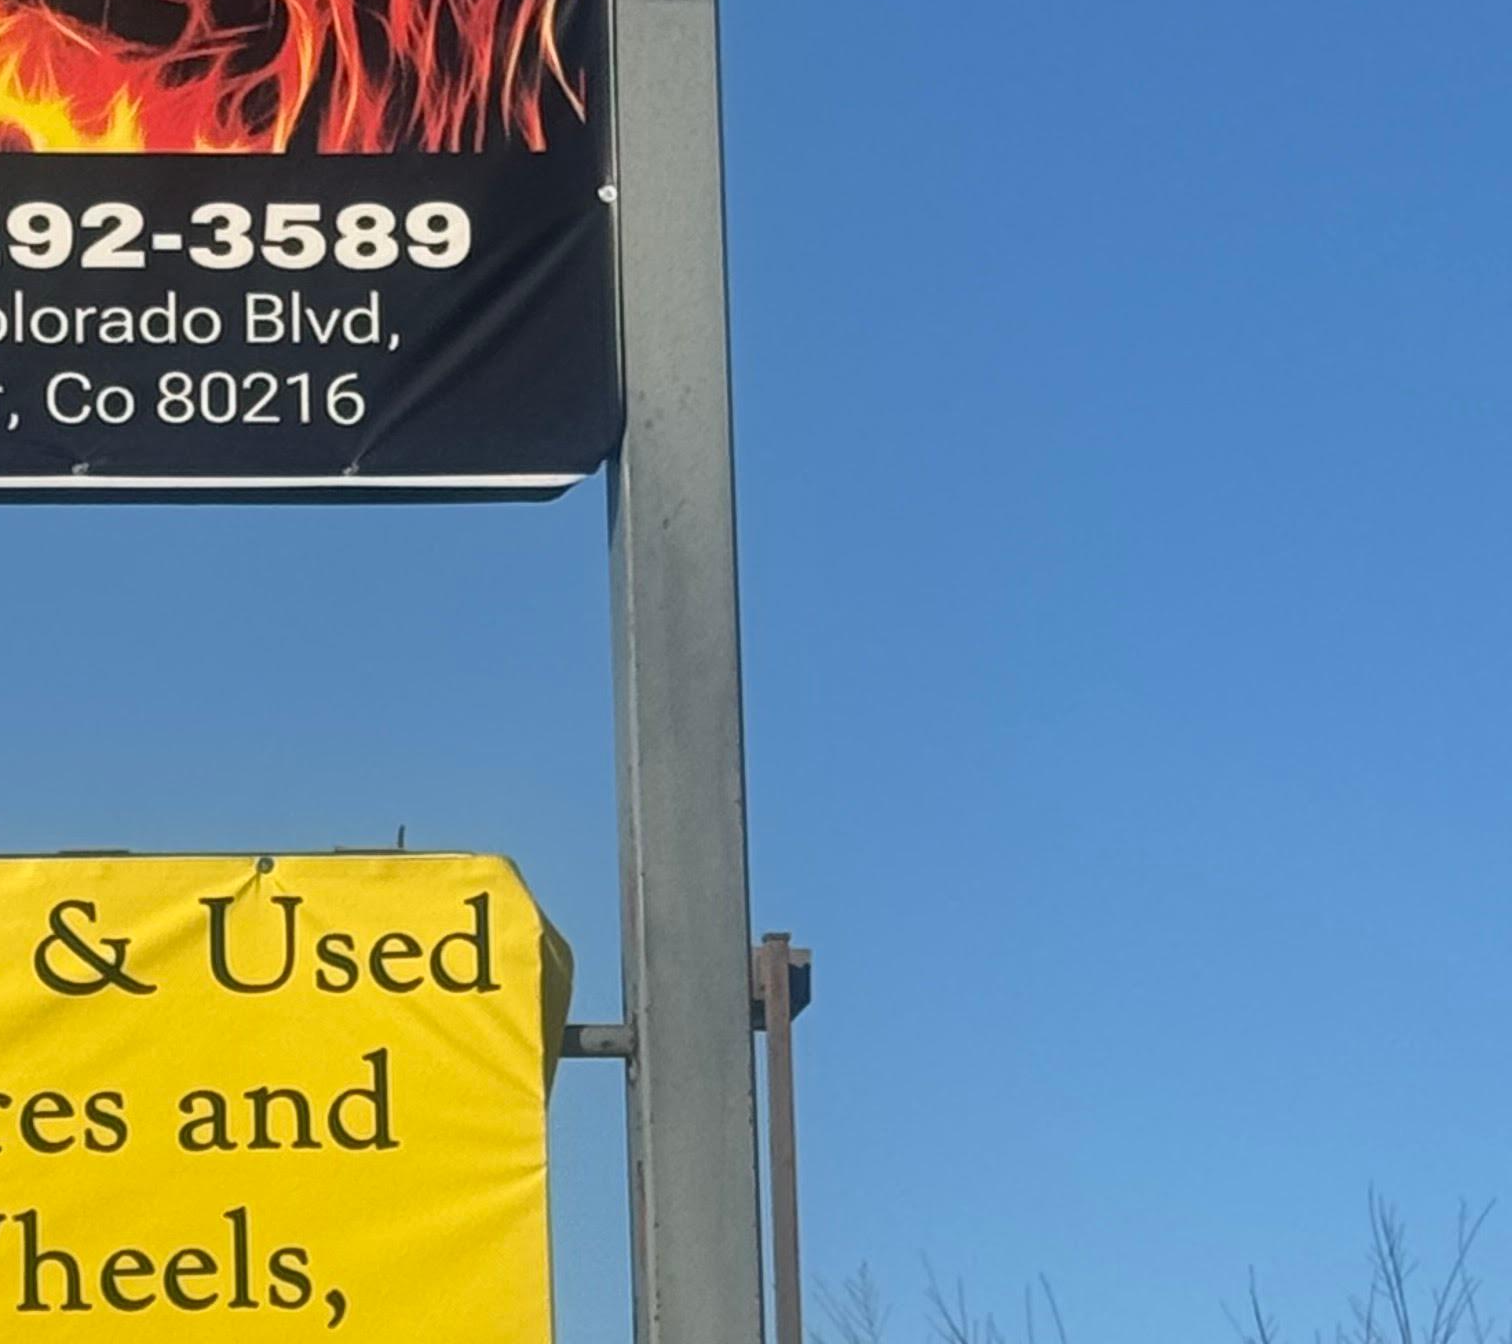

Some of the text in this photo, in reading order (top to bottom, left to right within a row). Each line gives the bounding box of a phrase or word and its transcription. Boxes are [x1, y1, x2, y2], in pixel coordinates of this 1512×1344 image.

[247, 291, 398, 350] Blvd,
[47, 372, 134, 423] Co
[158, 372, 364, 424] 80216
[35, 900, 156, 995] &
[200, 893, 500, 993] Used
[179, 1048, 398, 1151] and
